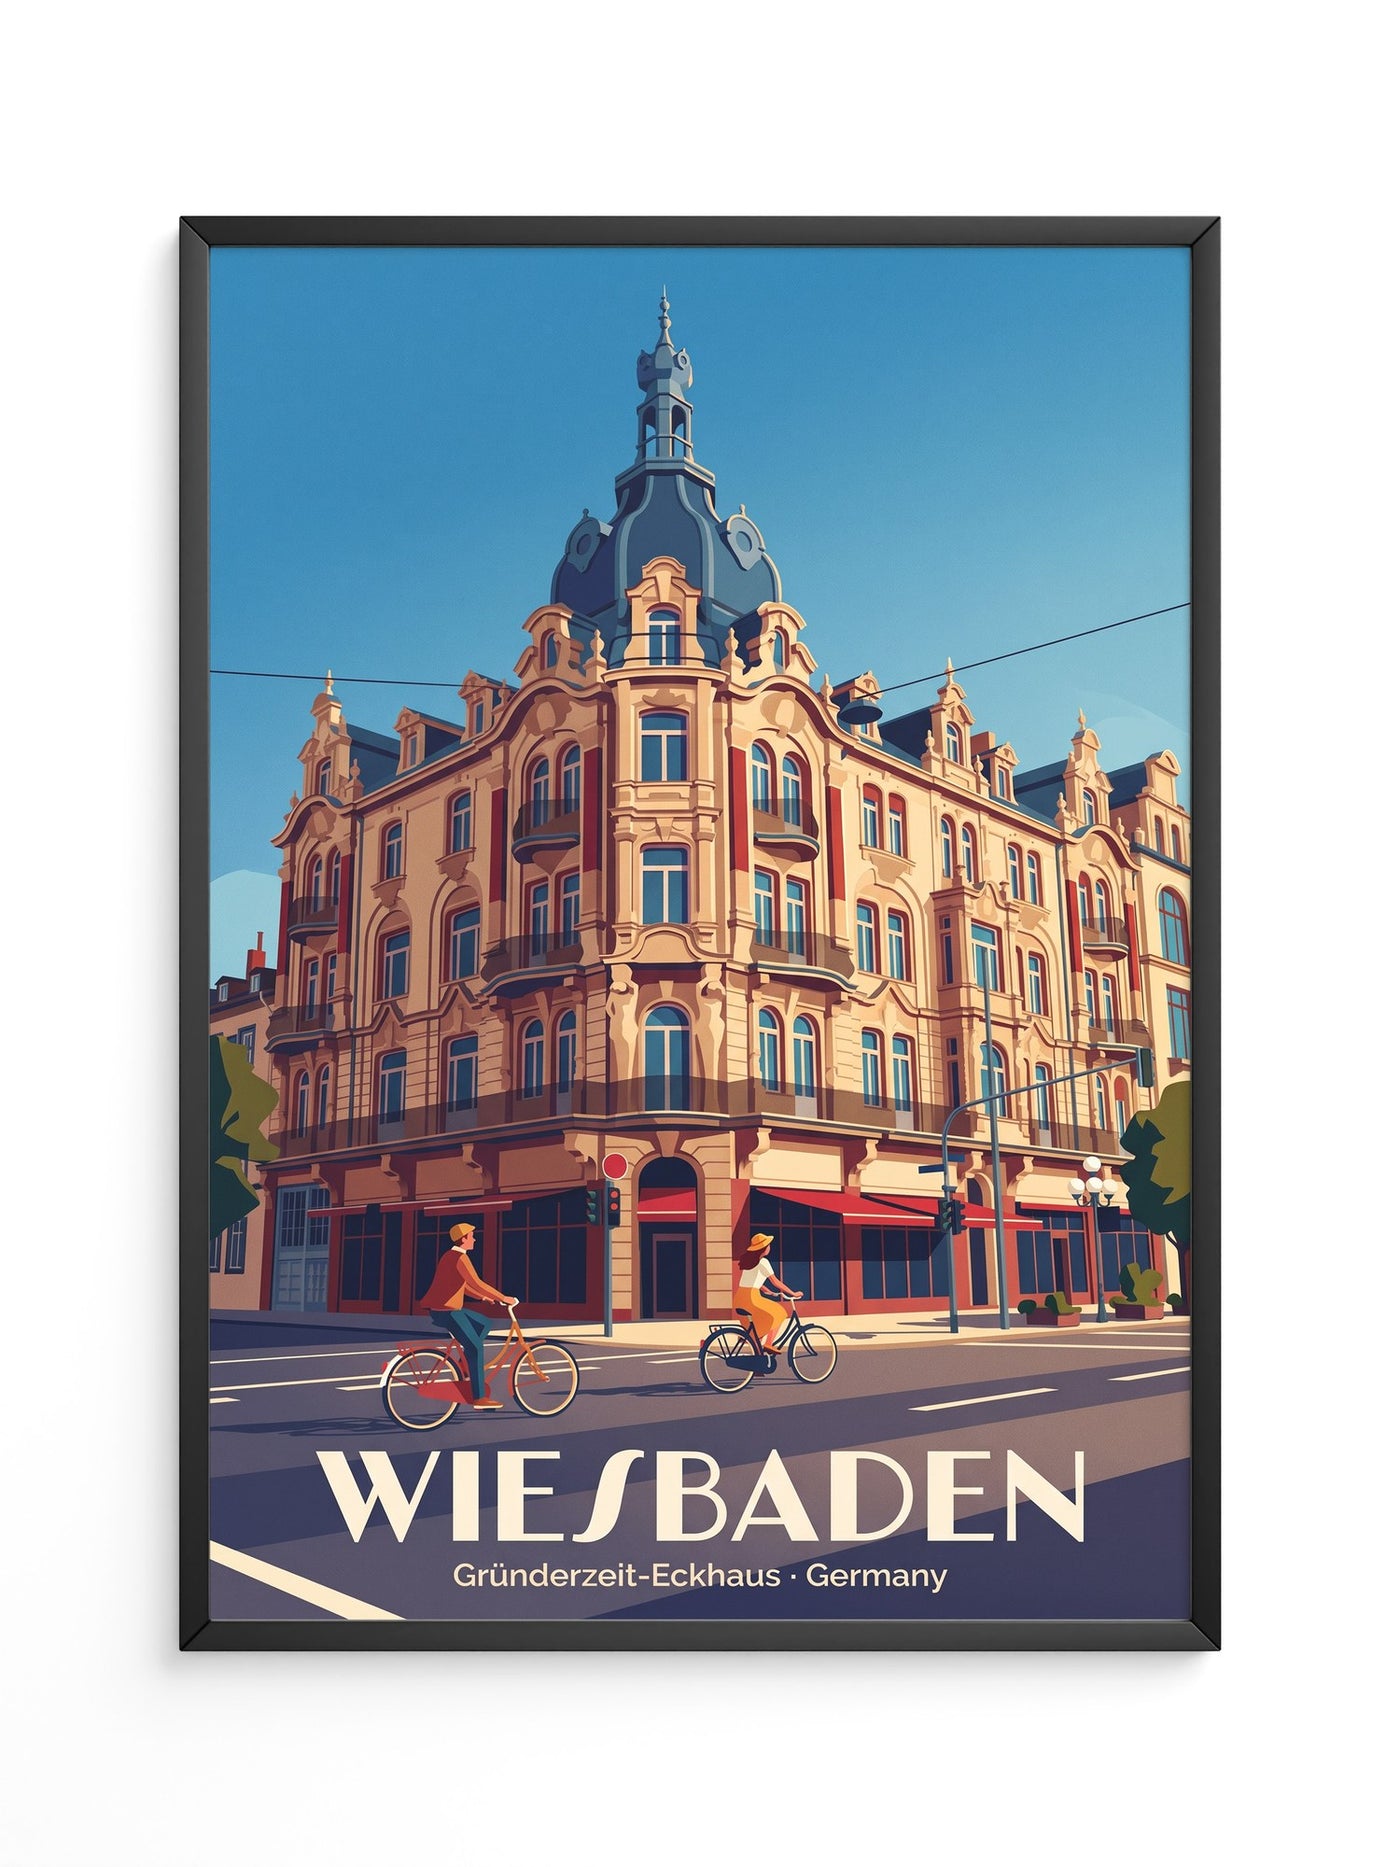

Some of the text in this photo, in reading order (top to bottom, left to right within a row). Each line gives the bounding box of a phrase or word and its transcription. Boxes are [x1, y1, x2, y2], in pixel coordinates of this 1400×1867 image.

[315, 1448, 1086, 1544] WIESBADEN
[453, 1561, 782, 1588] Gründerzeit-Eckhaus
[806, 1562, 949, 1594] Germany
